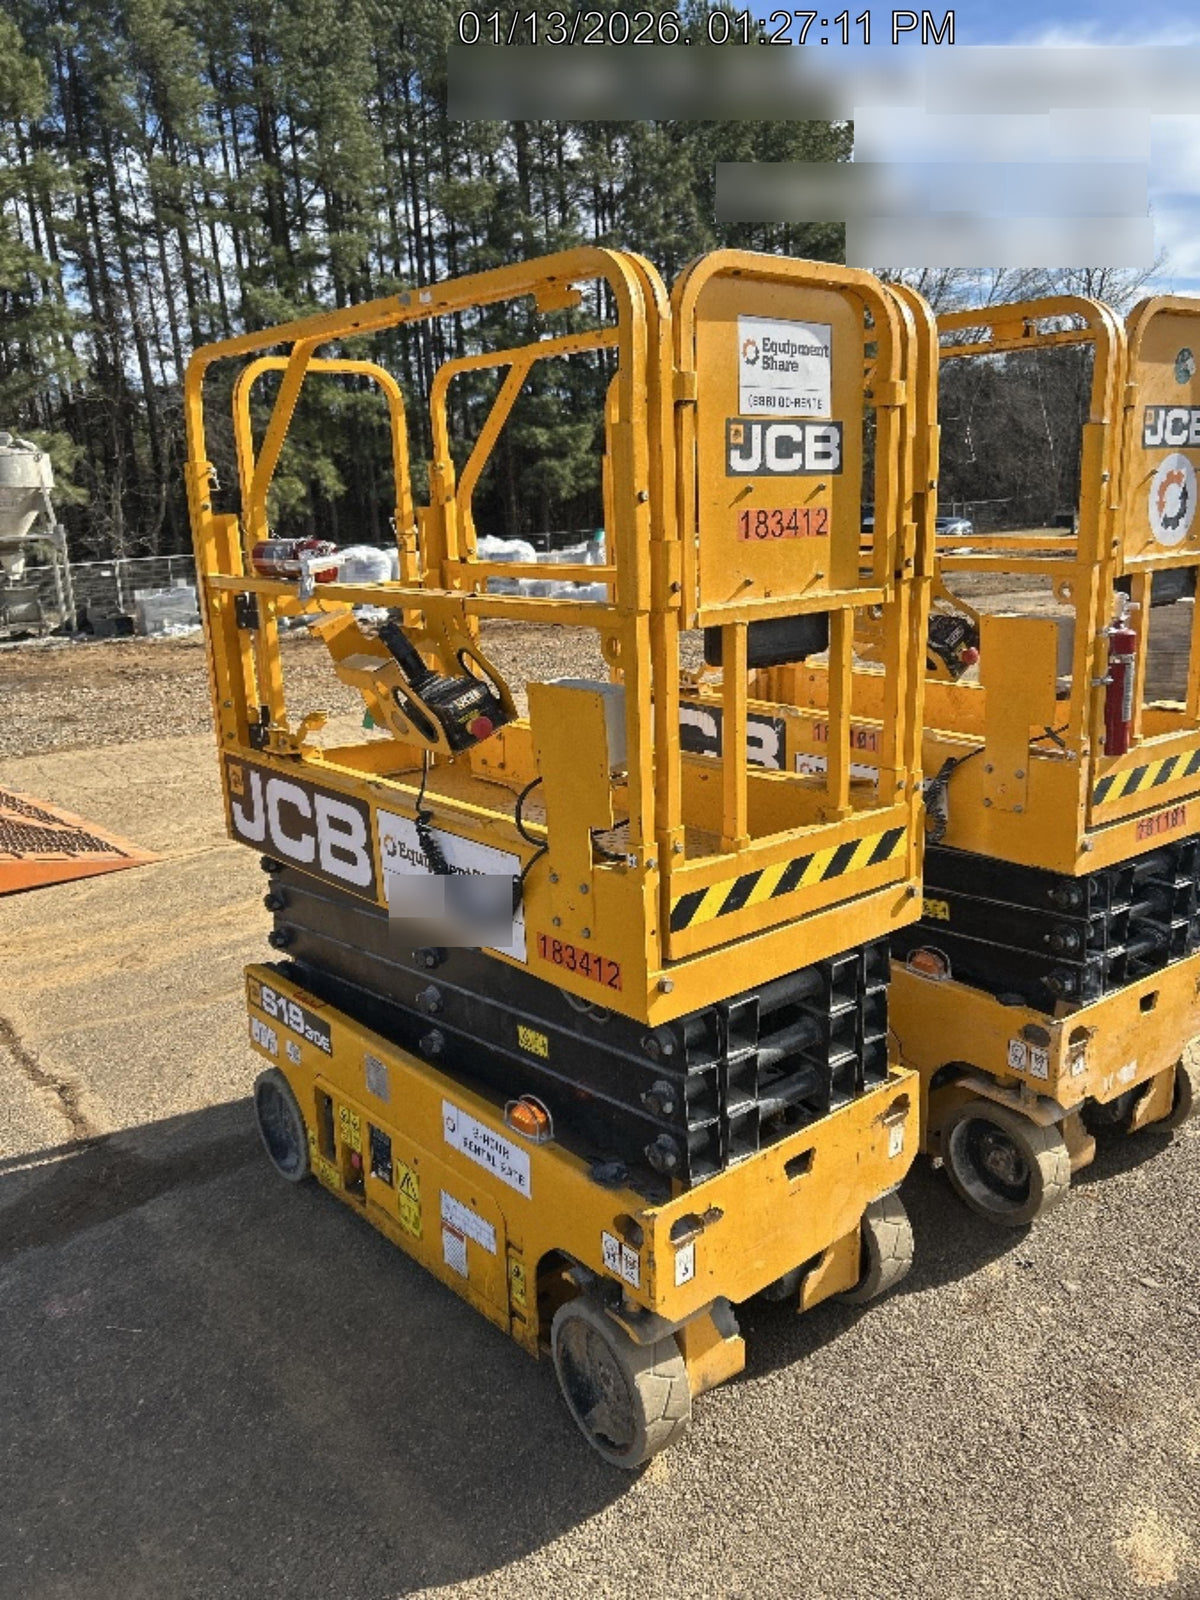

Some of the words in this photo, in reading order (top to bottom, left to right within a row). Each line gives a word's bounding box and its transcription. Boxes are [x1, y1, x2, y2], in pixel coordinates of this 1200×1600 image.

[762, 337, 829, 358] Equipment
[762, 356, 799, 373] Share
[730, 424, 840, 472] JCB
[740, 507, 828, 539] 183412
[231, 770, 372, 887] JCB
[540, 935, 622, 991] 183412
